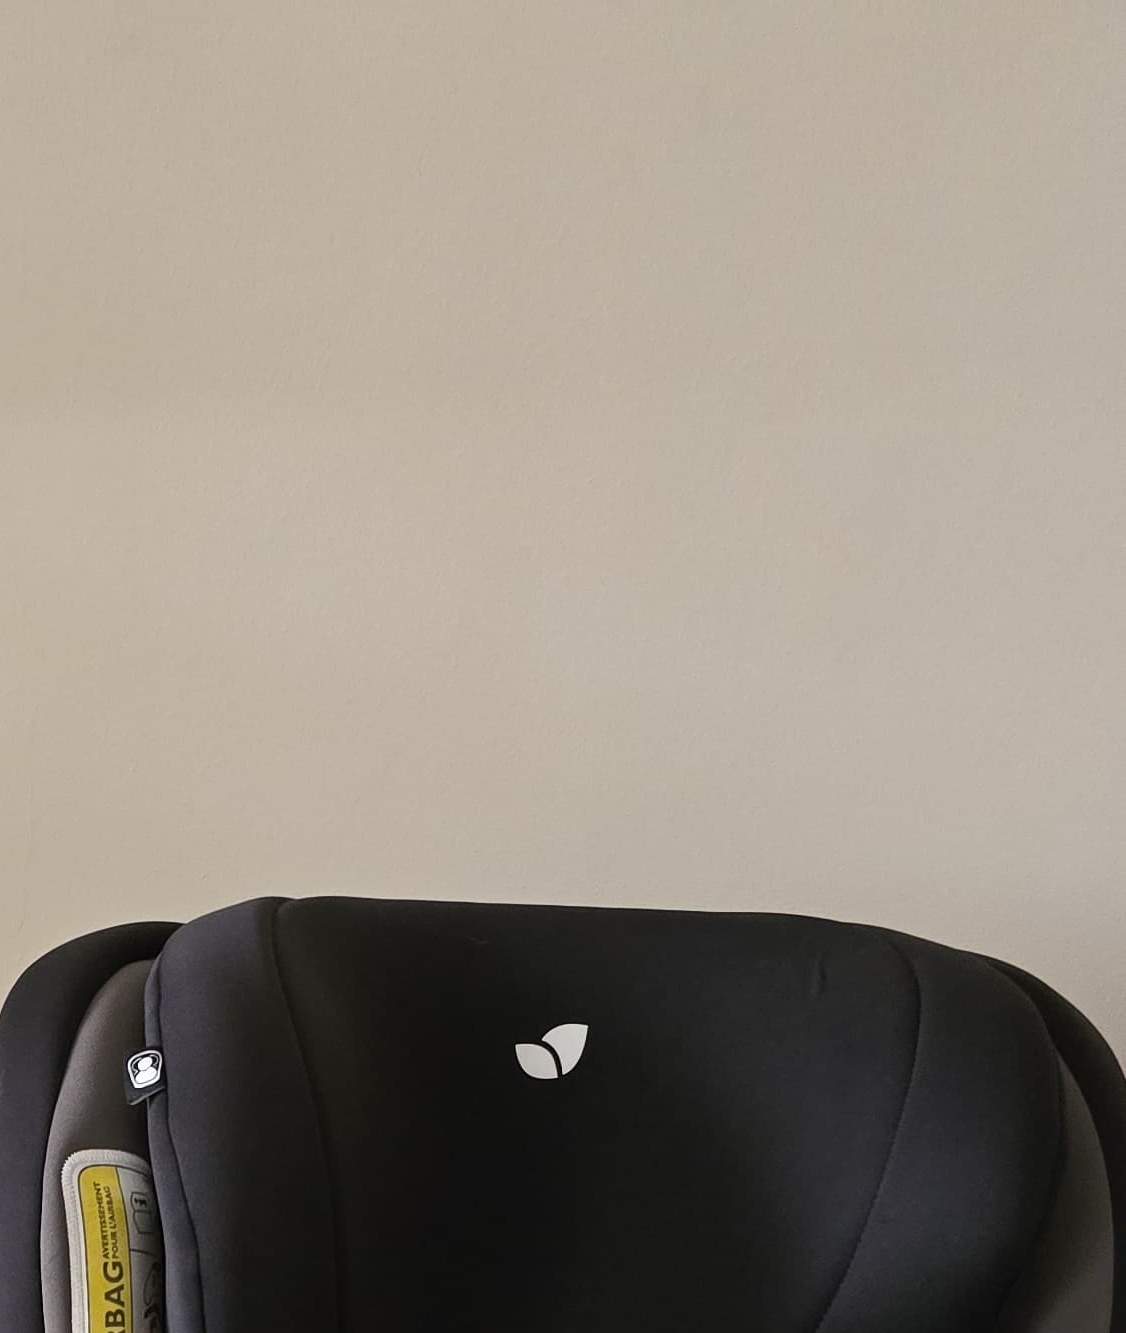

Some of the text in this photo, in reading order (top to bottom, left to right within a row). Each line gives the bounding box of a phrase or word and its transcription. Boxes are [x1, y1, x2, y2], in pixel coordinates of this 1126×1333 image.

[93, 1181, 110, 1259] AVERTISSEMENT
[103, 1186, 119, 1259] POUR L'AIRBAG
